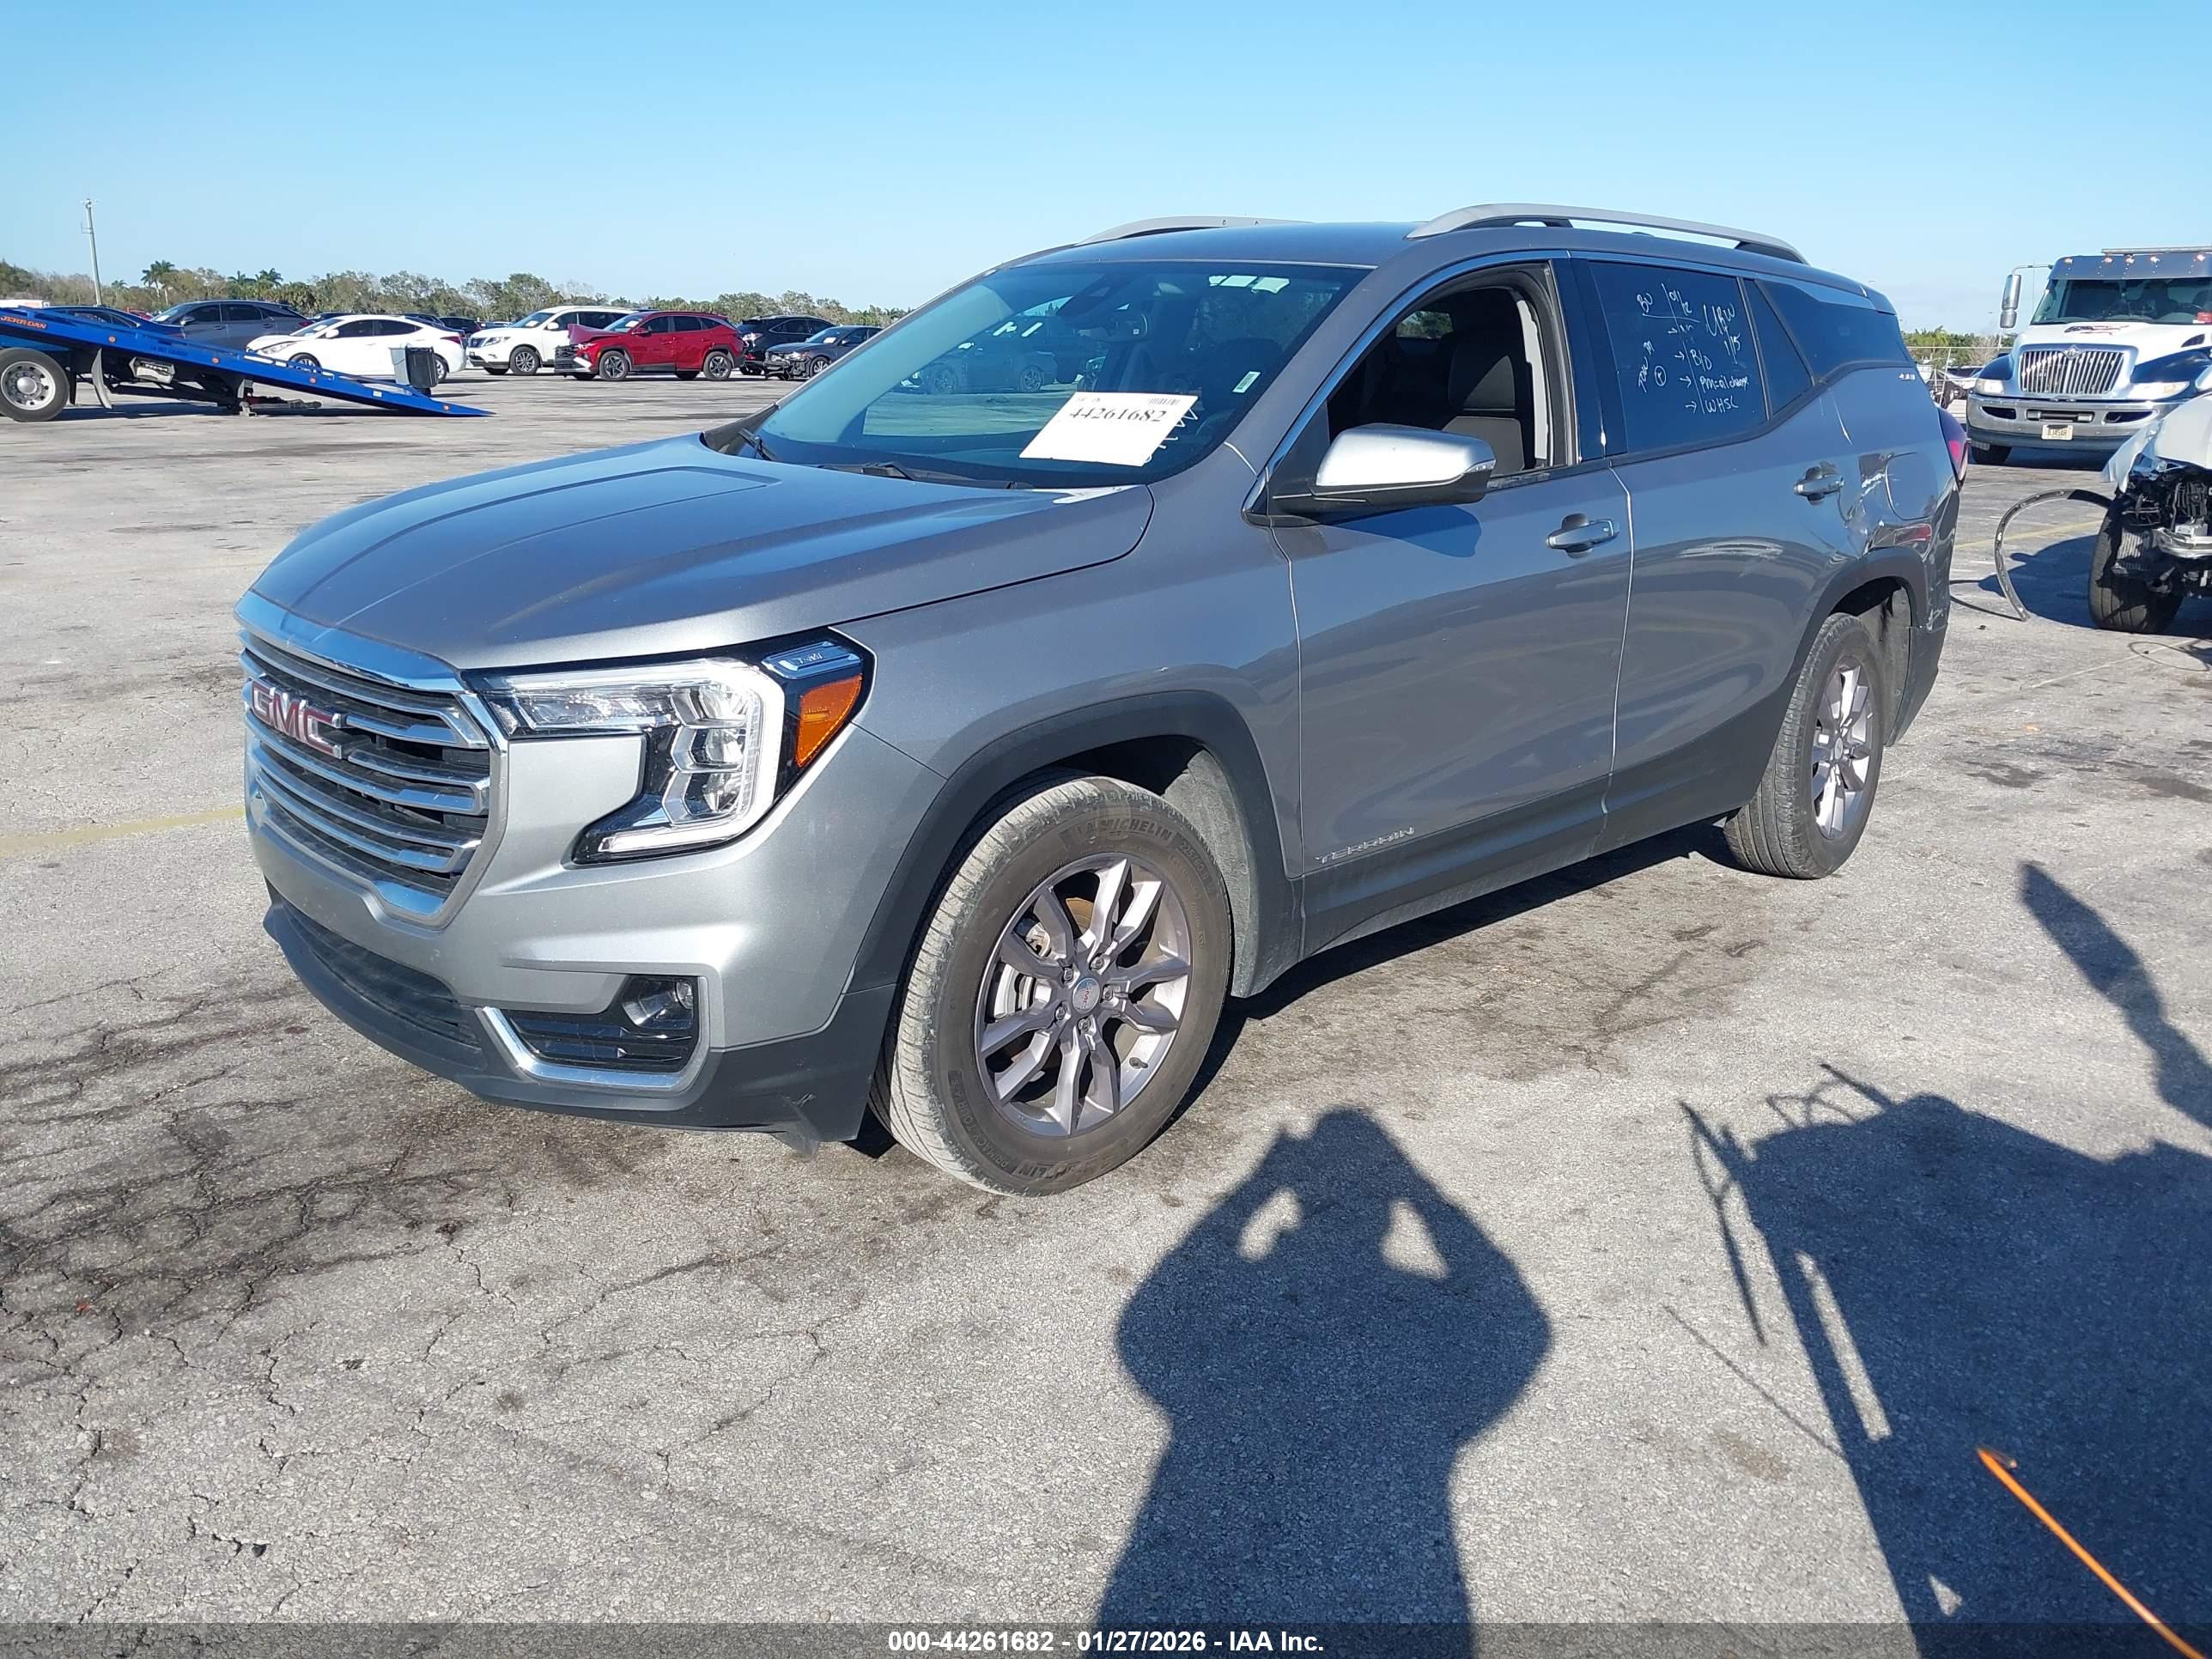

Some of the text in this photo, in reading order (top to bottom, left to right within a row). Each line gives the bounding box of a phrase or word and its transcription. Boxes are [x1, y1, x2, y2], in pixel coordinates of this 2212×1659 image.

[1069, 407, 1167, 422] 44261682
[250, 673, 343, 760] GMC
[1316, 826, 1415, 864] TERRAIN
[974, 1133, 1008, 1168] PRIMACY
